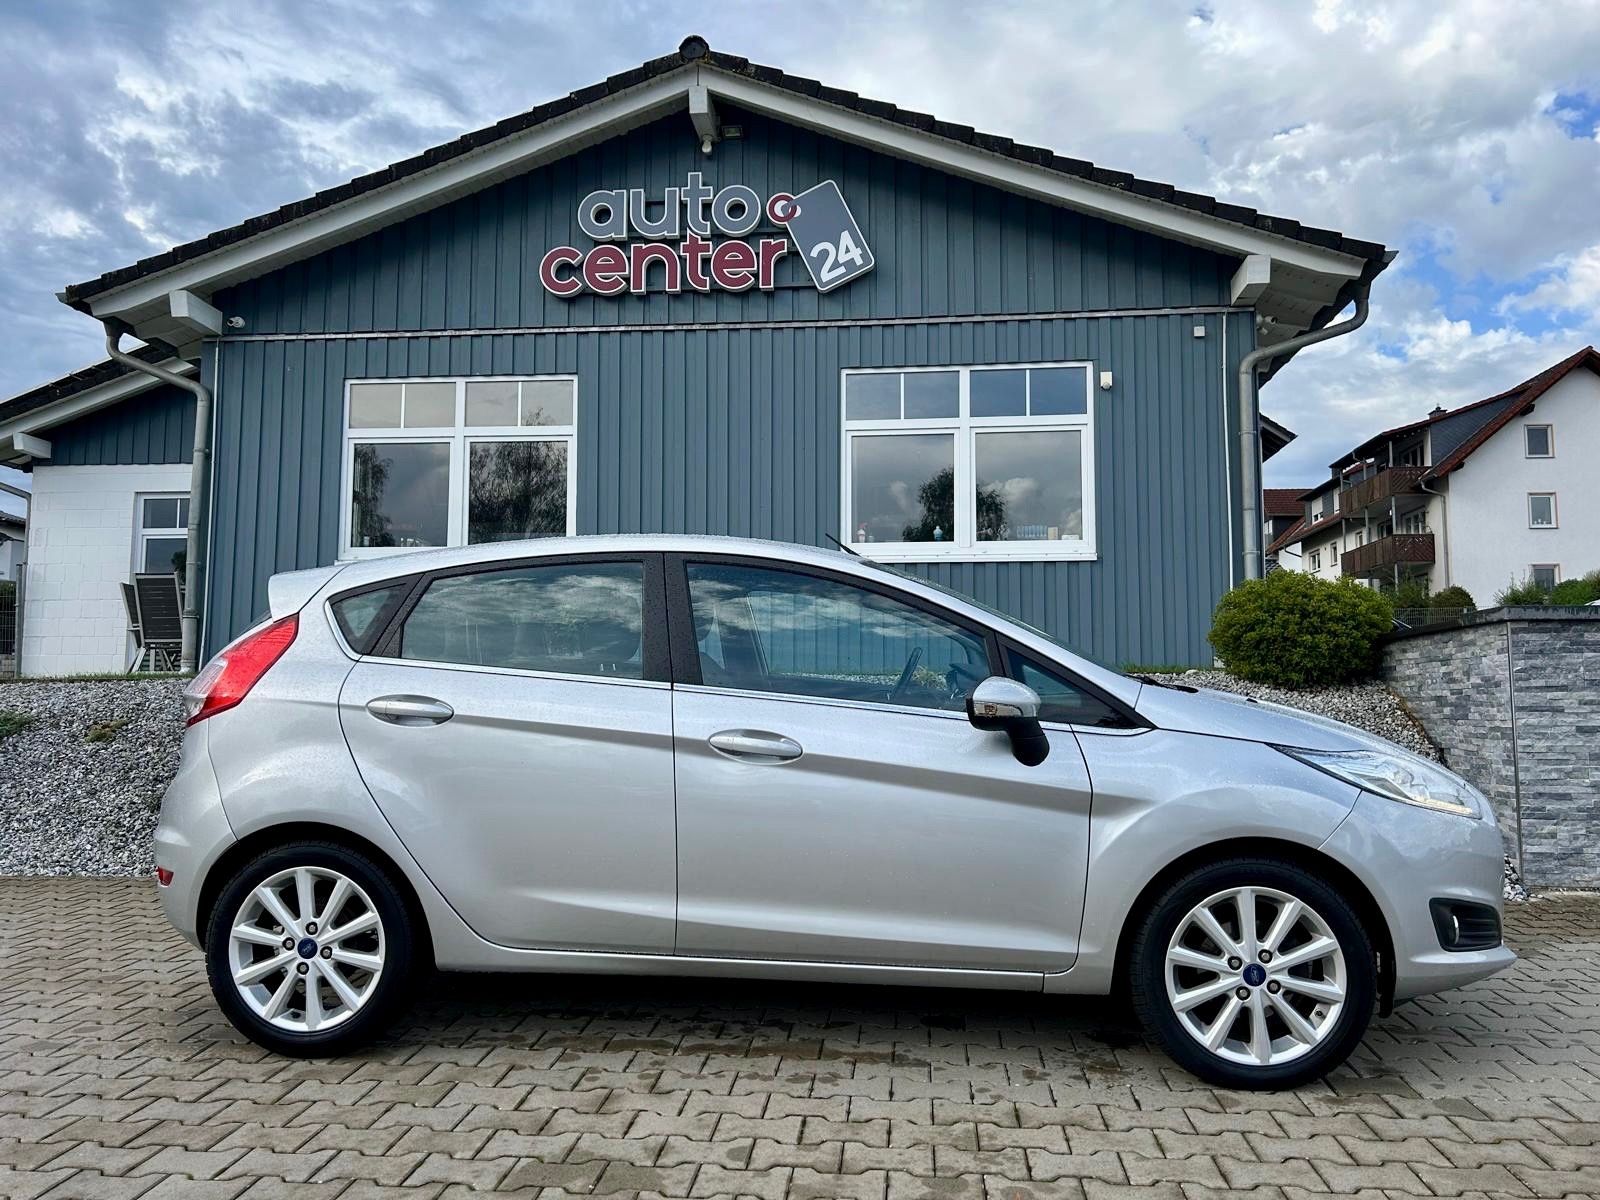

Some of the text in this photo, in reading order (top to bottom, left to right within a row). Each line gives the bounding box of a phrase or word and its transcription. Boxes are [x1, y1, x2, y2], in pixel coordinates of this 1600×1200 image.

[578, 172, 761, 240] auto
[539, 228, 788, 296] center
[809, 230, 864, 284] 24
